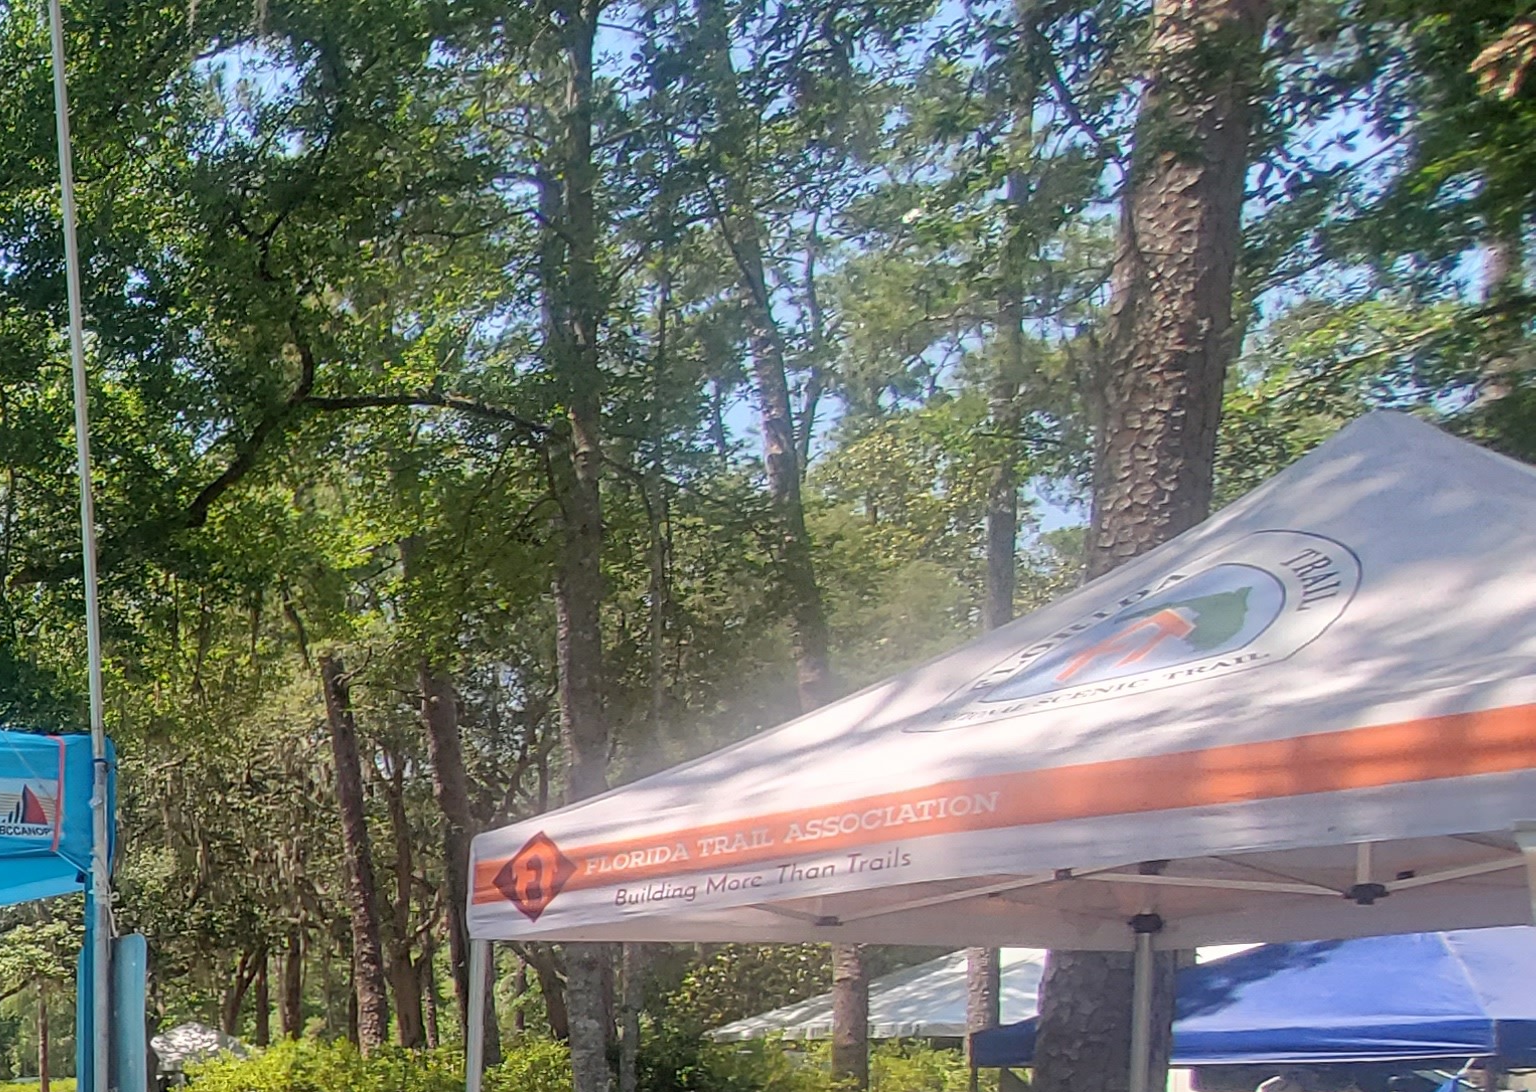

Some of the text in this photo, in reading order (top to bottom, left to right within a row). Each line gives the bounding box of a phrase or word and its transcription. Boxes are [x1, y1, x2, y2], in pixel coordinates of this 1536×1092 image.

[1280, 547, 1343, 613] TRAIL
[1162, 650, 1272, 680] TRAIL
[584, 790, 1002, 876] FLORIDA TRAIL ASSOCIATION
[615, 846, 912, 908] Building More Than Trails
